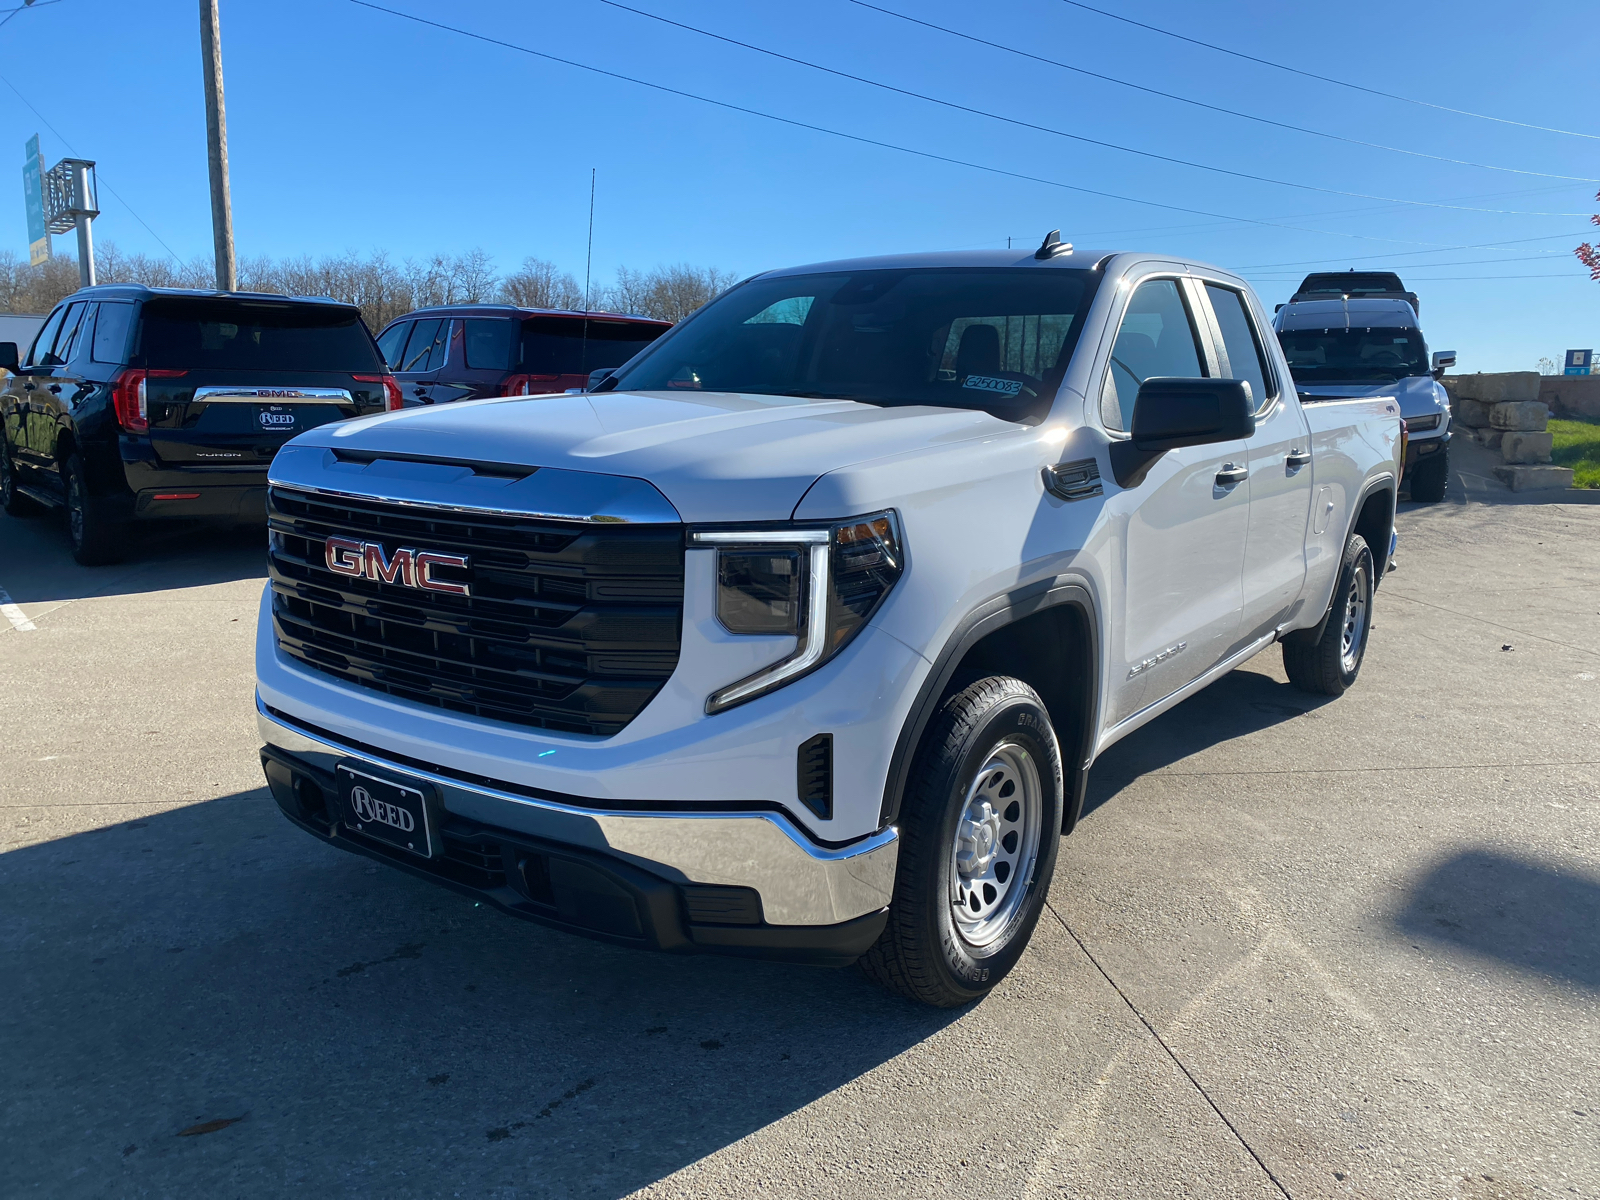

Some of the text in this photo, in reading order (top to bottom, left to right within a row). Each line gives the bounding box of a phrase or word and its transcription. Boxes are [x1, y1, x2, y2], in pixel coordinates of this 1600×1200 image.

[257, 389, 299, 399] GMC
[965, 376, 1021, 392] G250083
[259, 412, 295, 425] REED
[325, 534, 471, 597] GMC
[1126, 641, 1187, 680] SIERRA
[352, 786, 415, 832] REED
[944, 930, 990, 982] GENERAL
